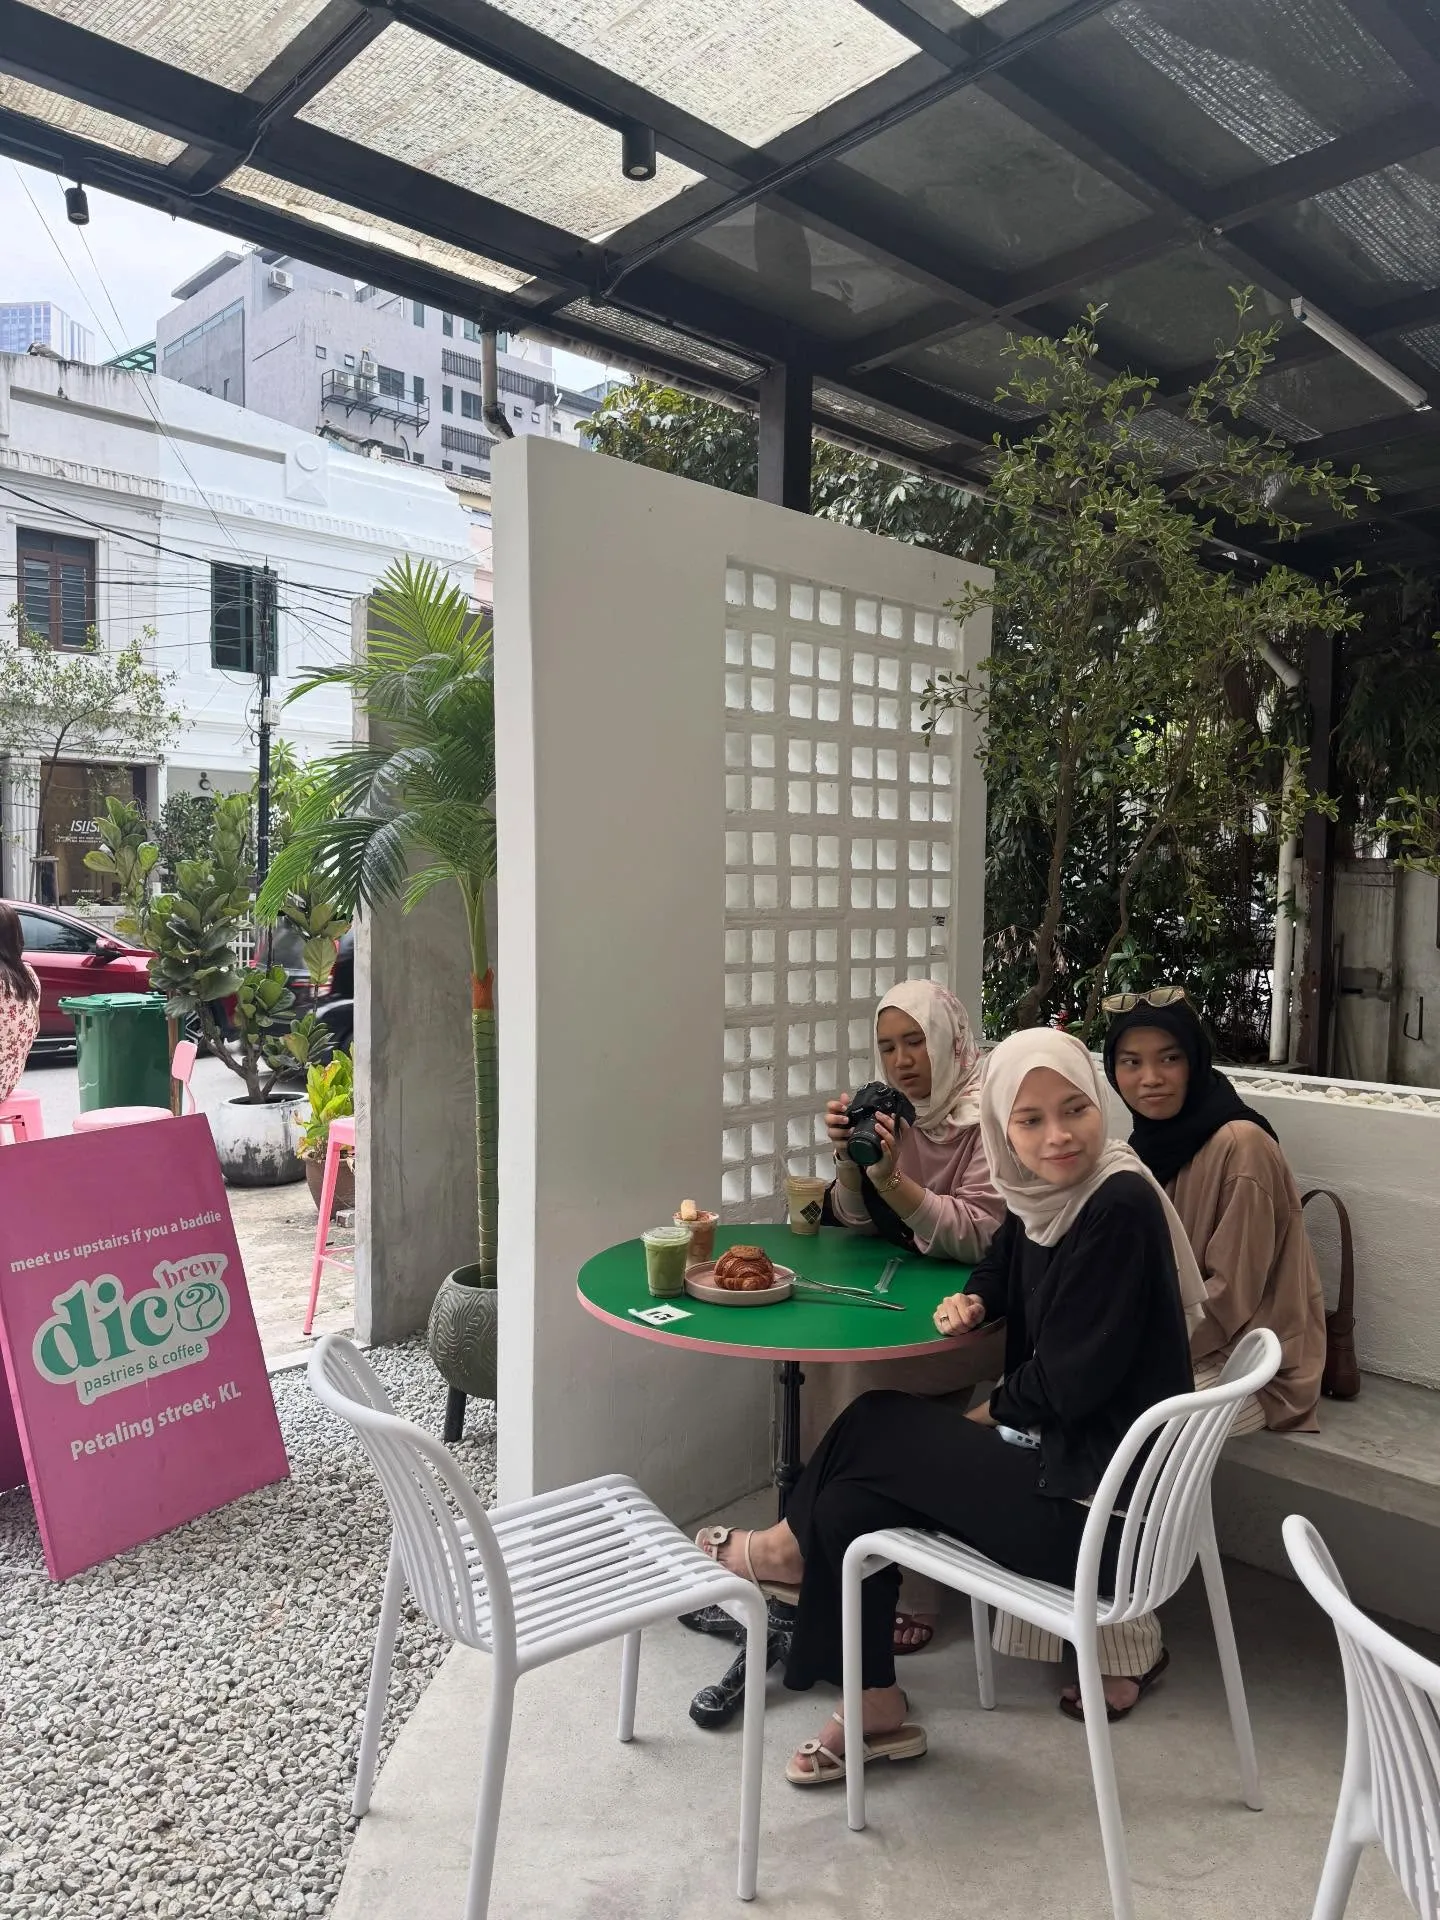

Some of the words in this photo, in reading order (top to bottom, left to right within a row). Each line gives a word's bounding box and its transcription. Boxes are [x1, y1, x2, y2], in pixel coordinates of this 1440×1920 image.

[11, 1252, 51, 1272] meet
[53, 1248, 71, 1262] us
[73, 1234, 130, 1258] upstairs
[131, 1229, 141, 1243] if
[144, 1224, 168, 1242] you
[170, 1222, 178, 1232] a
[180, 1211, 222, 1231] baddie
[160, 1260, 223, 1289] brew
[84, 1364, 144, 1396] pastries
[148, 1355, 159, 1370] &
[162, 1342, 203, 1365] coffee
[70, 1416, 154, 1461] Petaling
[158, 1391, 216, 1427] street,
[218, 1381, 241, 1402] KL
